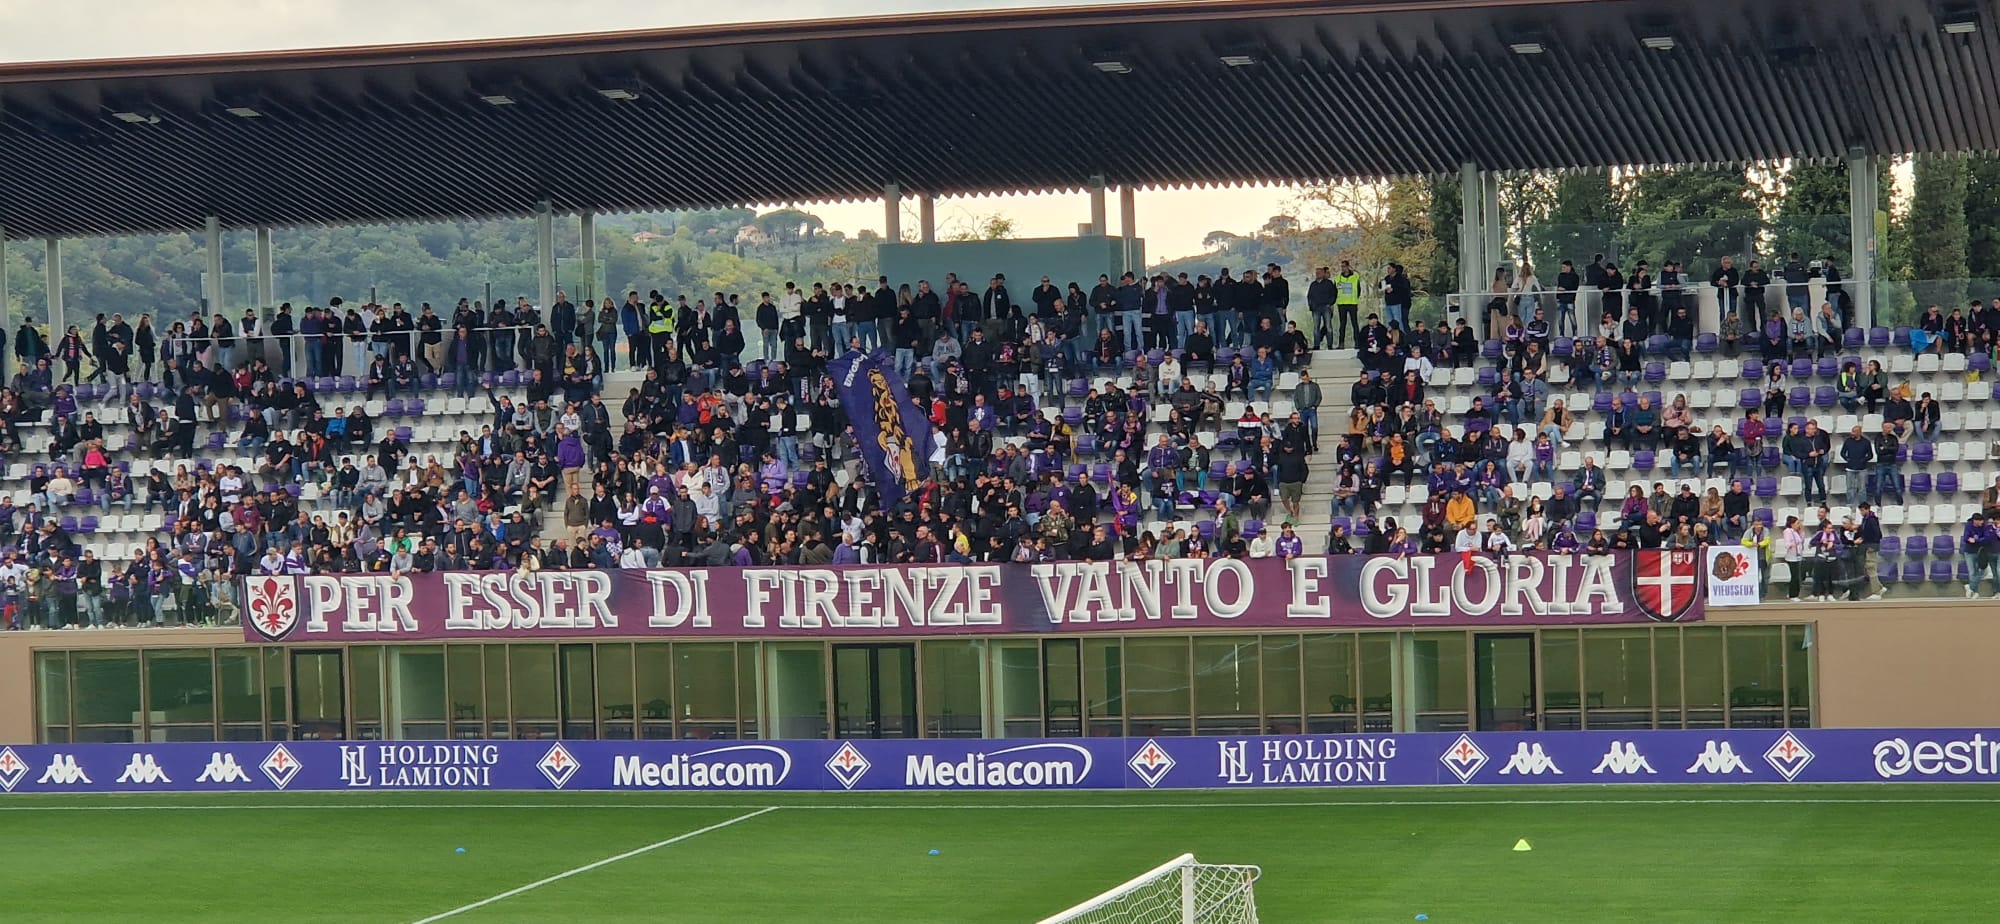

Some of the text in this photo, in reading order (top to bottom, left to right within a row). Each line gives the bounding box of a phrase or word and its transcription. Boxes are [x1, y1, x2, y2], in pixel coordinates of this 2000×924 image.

[305, 554, 1624, 632] PER ESSER DI FIRENZE VANTO E GLORIA
[1713, 584, 1754, 597] VIEUSSEUX
[379, 745, 499, 765] HOLDING
[1262, 738, 1397, 761] HOLDING
[379, 766, 490, 786] LAMIONI
[613, 753, 774, 787] Mediacom
[905, 752, 1074, 786] Mediacom
[1262, 761, 1387, 784] LAMIONI
